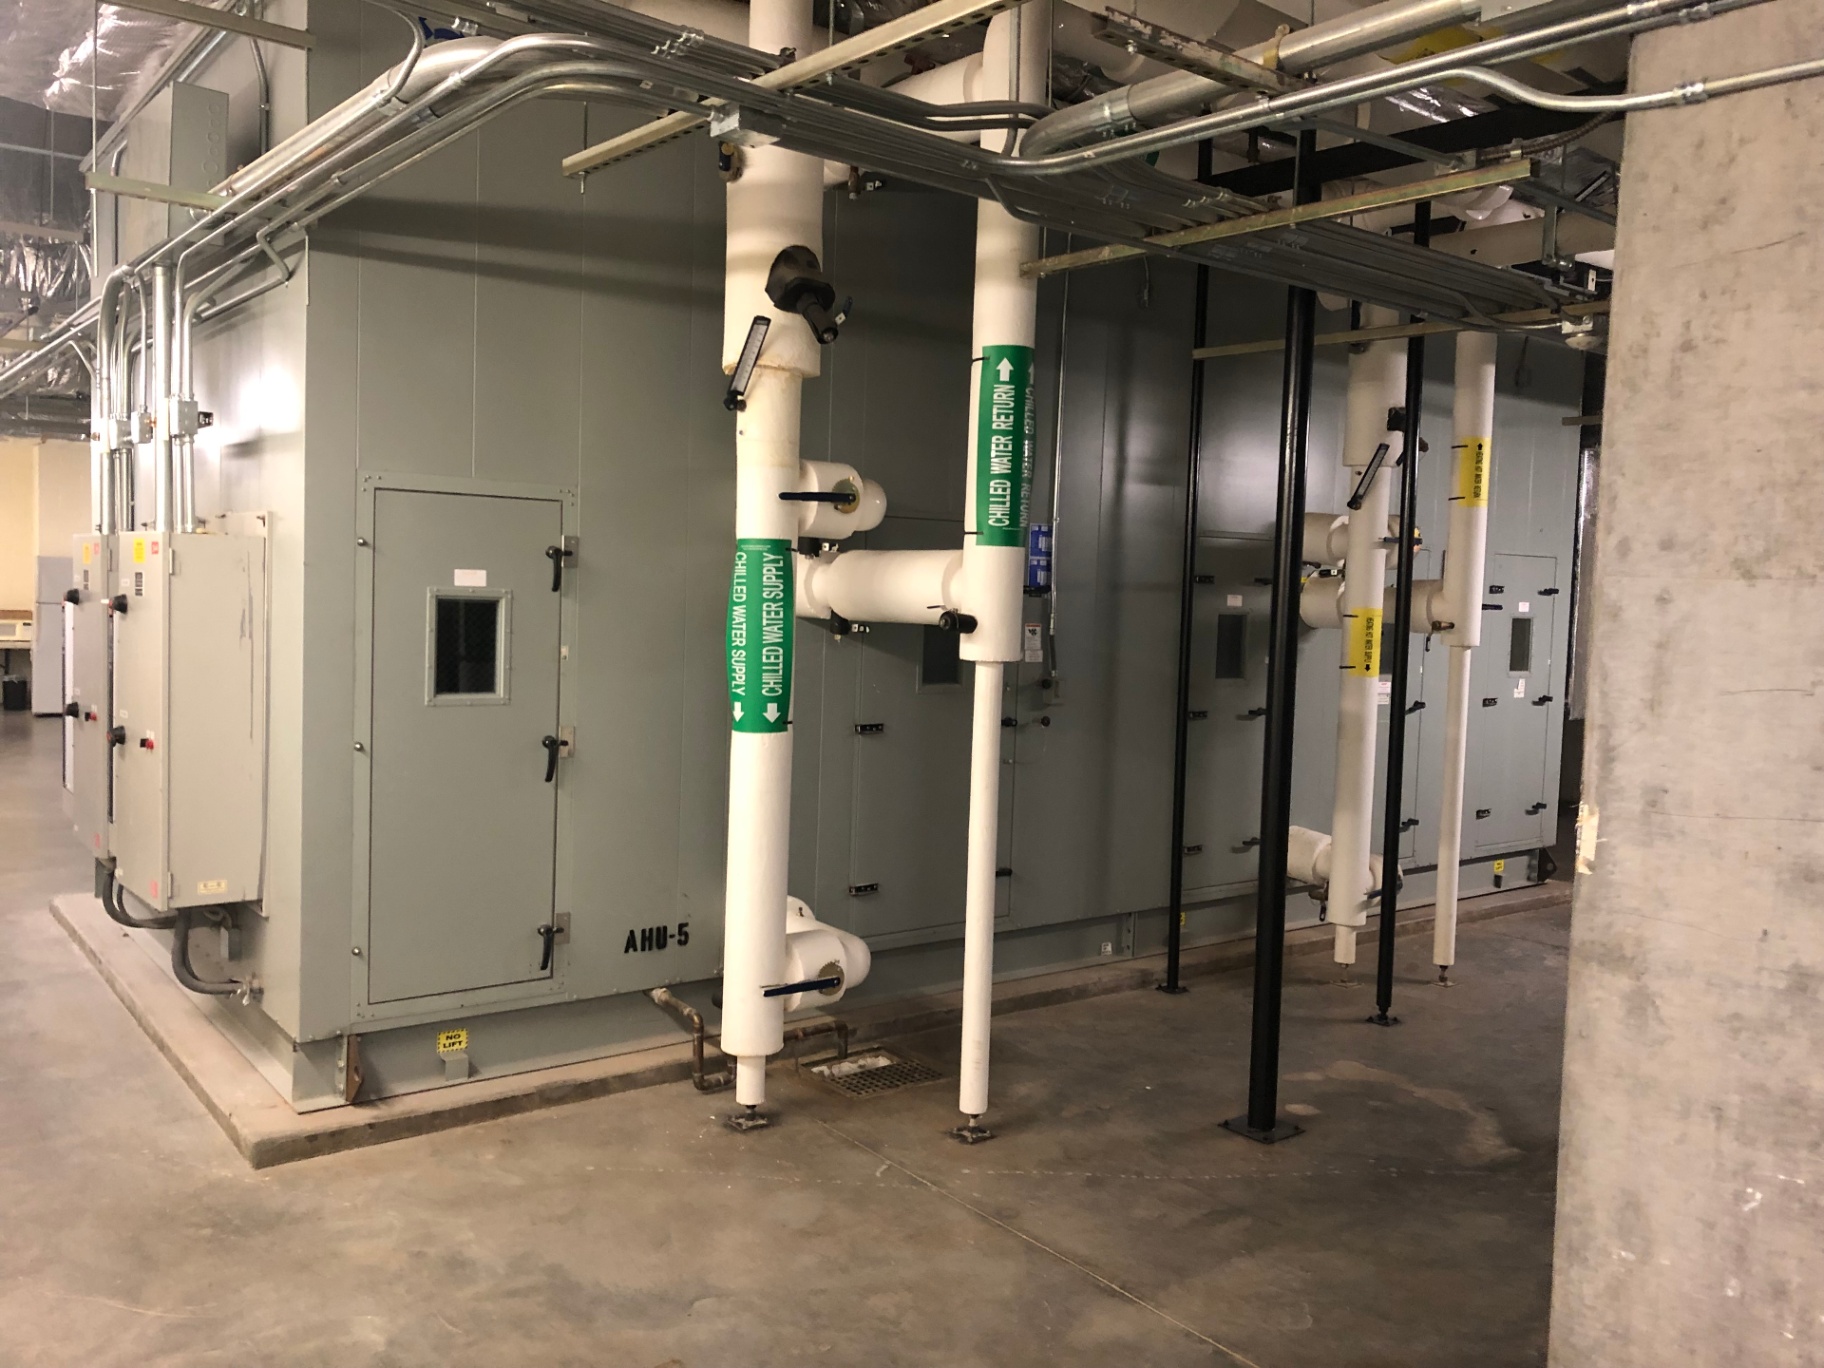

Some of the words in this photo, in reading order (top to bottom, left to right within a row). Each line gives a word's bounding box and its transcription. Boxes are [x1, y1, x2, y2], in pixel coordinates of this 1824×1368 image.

[992, 384, 1015, 430] RETURN
[990, 435, 1013, 474] WATER
[1022, 440, 1033, 478] WATER
[988, 479, 1011, 527] CHILLED
[1020, 483, 1031, 527] RETURN
[733, 552, 747, 602] CHILLED
[763, 552, 784, 599] SUPPLY
[731, 605, 747, 647] WATER
[763, 602, 783, 643] WATER
[731, 649, 747, 696] SUPPLY
[761, 646, 783, 696] CHILLED
[624, 922, 689, 953] AHU-5
[443, 1041, 463, 1049] LIFT
